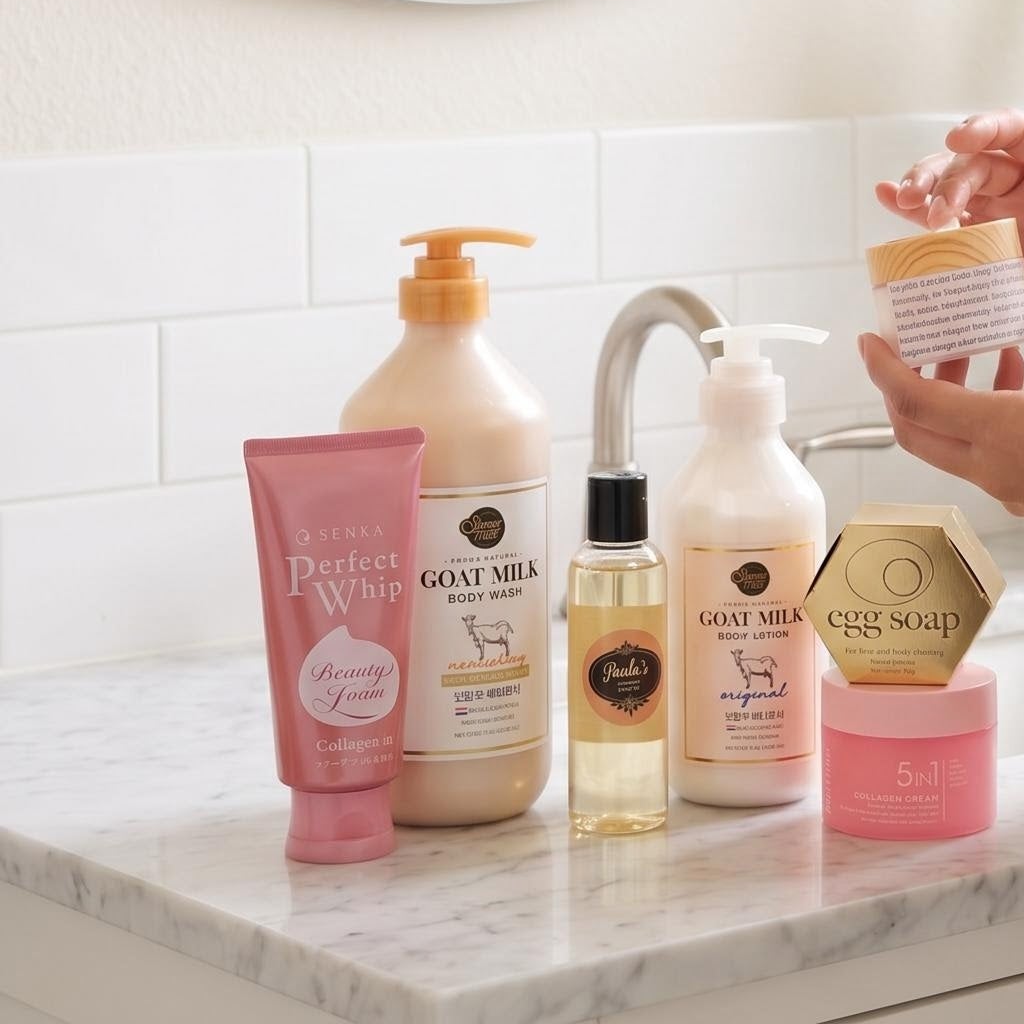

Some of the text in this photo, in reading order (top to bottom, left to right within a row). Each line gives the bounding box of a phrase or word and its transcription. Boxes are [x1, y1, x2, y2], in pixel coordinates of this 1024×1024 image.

[320, 525, 384, 541] SENKA
[285, 550, 399, 597] Perfect
[420, 559, 539, 588] GOAT MILK
[312, 576, 402, 617] Whip
[448, 587, 523, 604] BODY WASH
[699, 607, 804, 627] GOAT MILK
[827, 609, 961, 639] egg soap
[311, 662, 394, 688] Beauty
[602, 657, 649, 683] Paula's
[316, 737, 380, 753] Collagen
[854, 792, 903, 802] COLLAGEN
